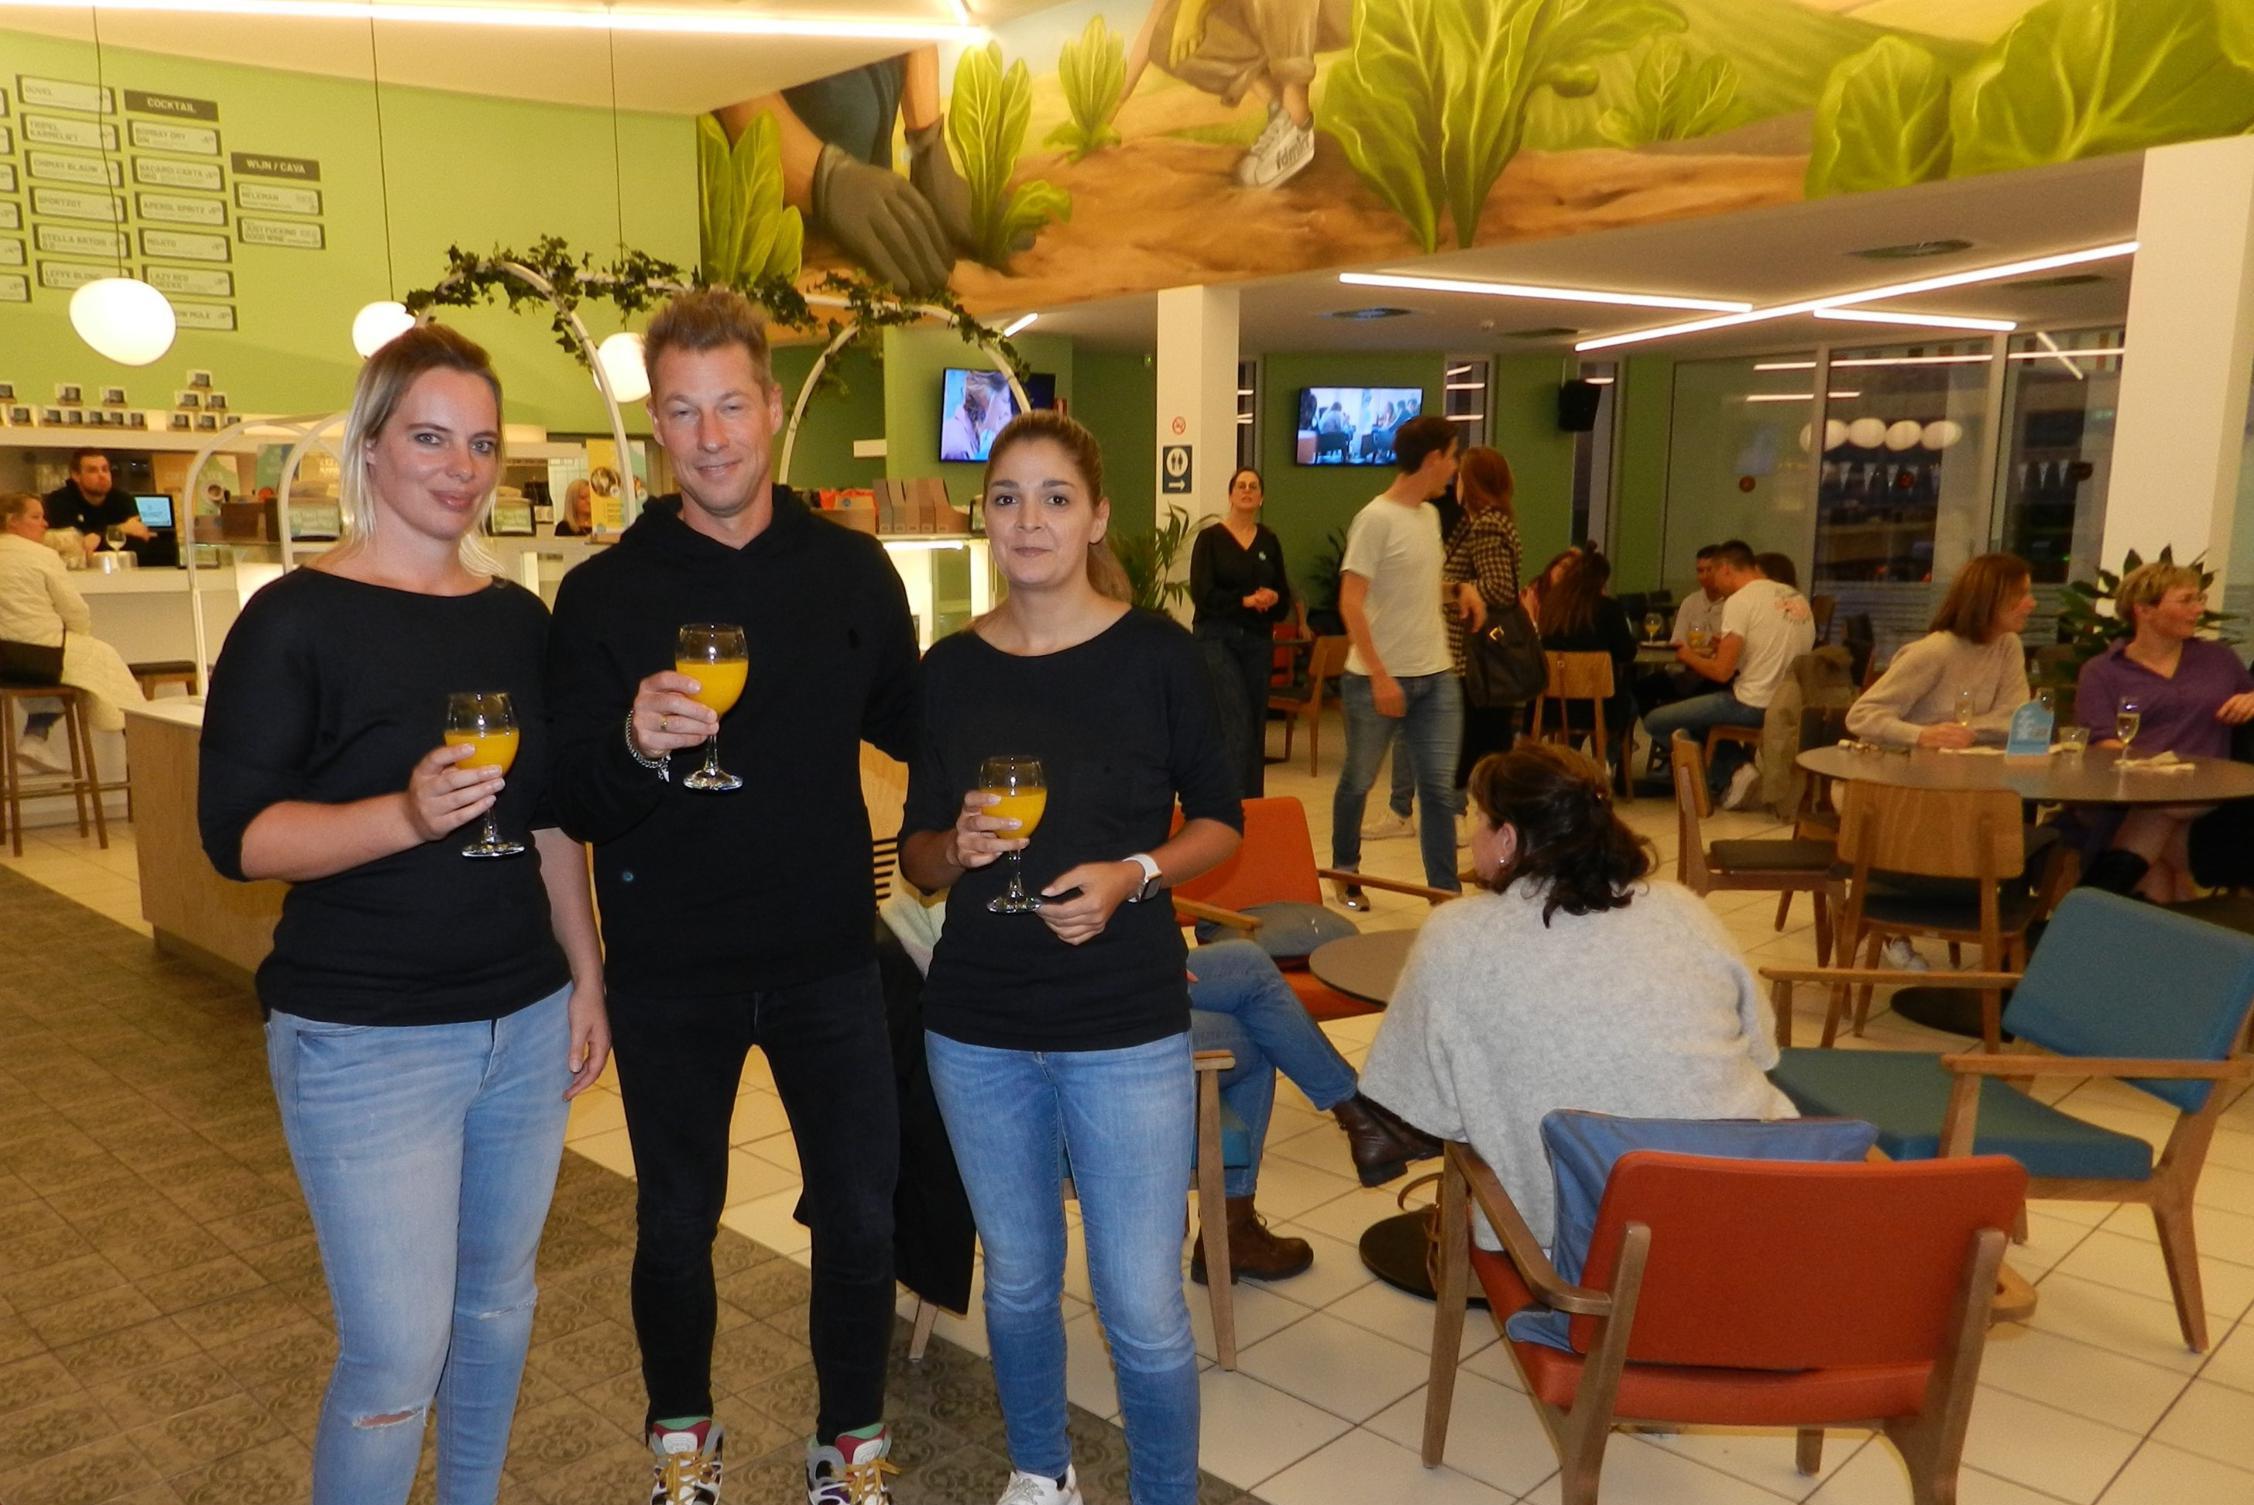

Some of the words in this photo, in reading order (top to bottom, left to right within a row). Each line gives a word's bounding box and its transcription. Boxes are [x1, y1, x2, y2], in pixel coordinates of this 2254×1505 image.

[146, 96, 197, 114] COCKTAIL
[246, 158, 272, 170] WIJN
[280, 162, 306, 174] CAVA
[143, 201, 174, 211] APEROL
[42, 232, 74, 243] STELLA
